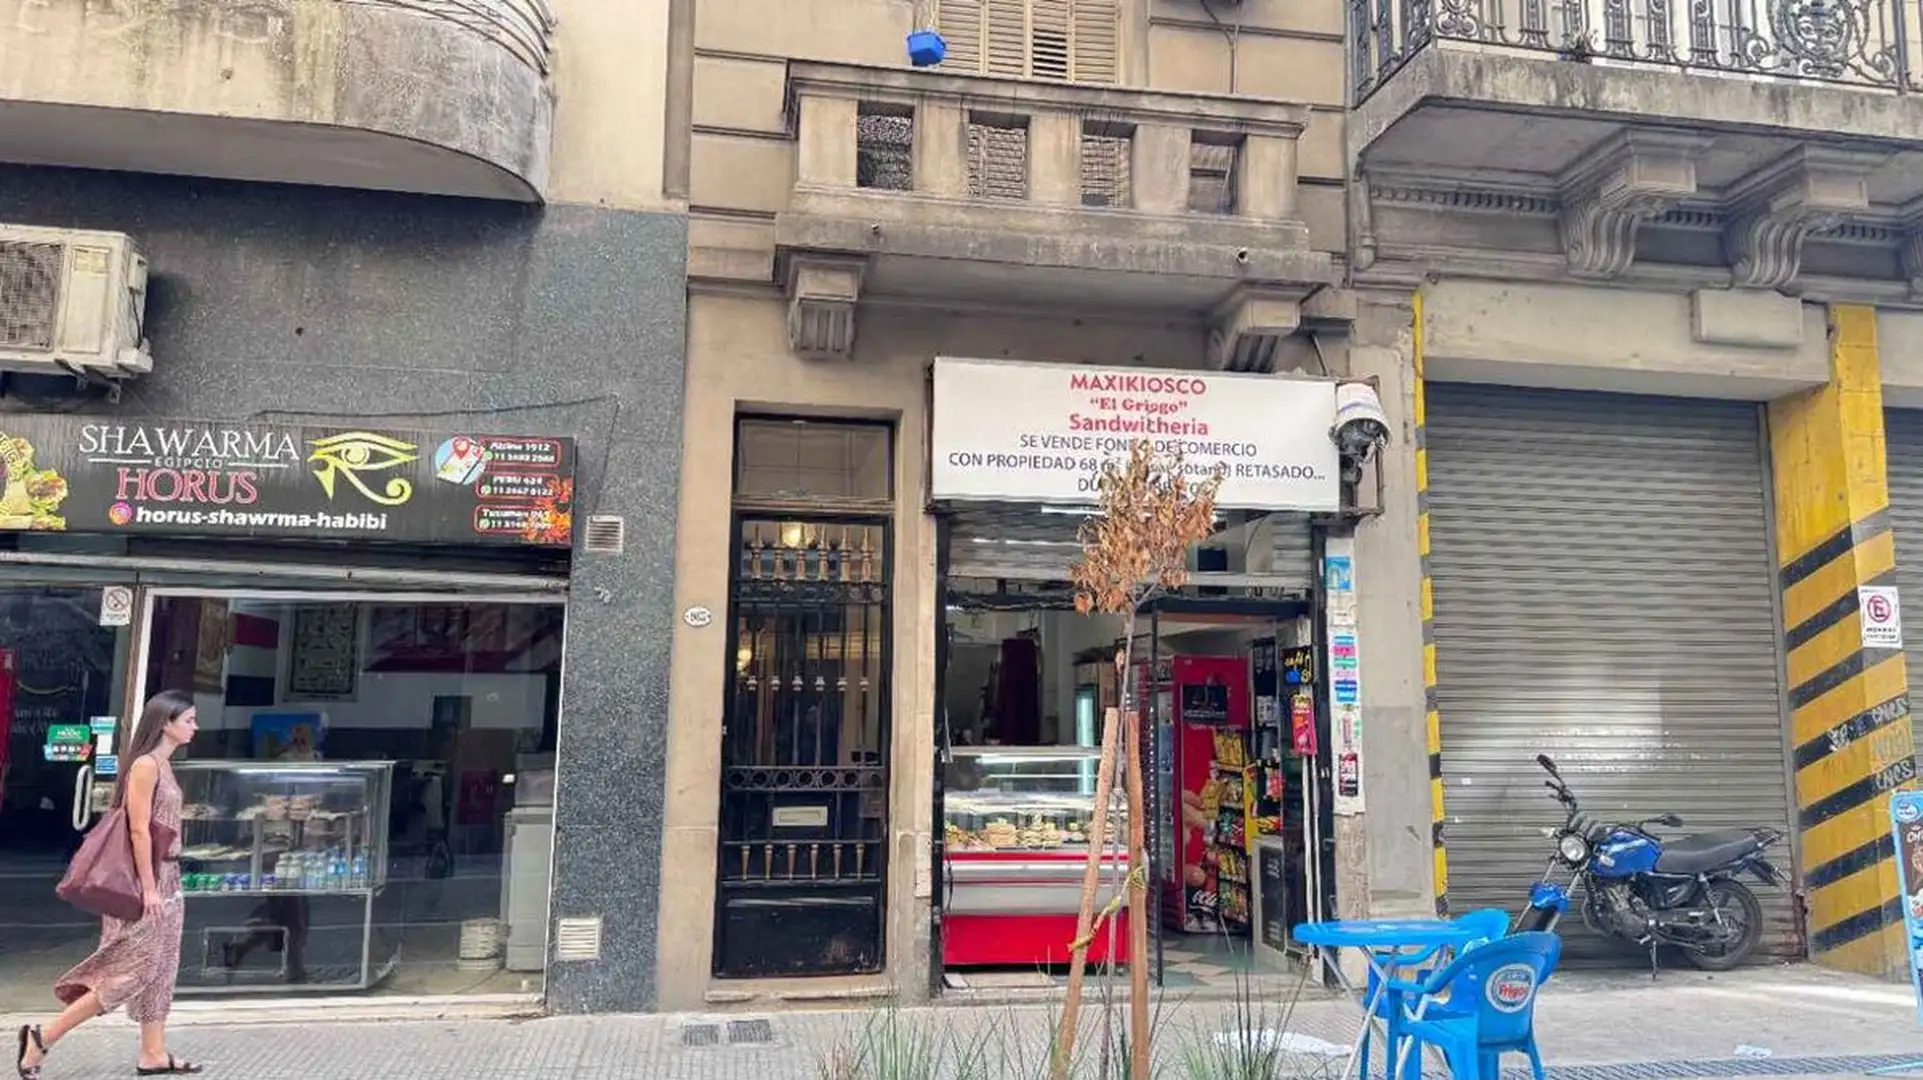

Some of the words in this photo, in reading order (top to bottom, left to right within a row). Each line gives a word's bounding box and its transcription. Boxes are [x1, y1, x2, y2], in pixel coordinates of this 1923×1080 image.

[1070, 374, 1206, 395] MAXIKIOSCO
[79, 424, 299, 461] SHAWARMA
[1020, 434, 1038, 448] SE
[1041, 435, 1093, 451] VENDE
[1177, 439, 1258, 458] COMERCIO
[154, 455, 223, 470] EGIPCIO
[949, 452, 983, 467] CON
[986, 453, 1076, 471] PROPIEDAD
[1079, 457, 1098, 471] 68
[115, 467, 258, 504] HORUS
[136, 507, 387, 530] horus-shawrma-habibi
